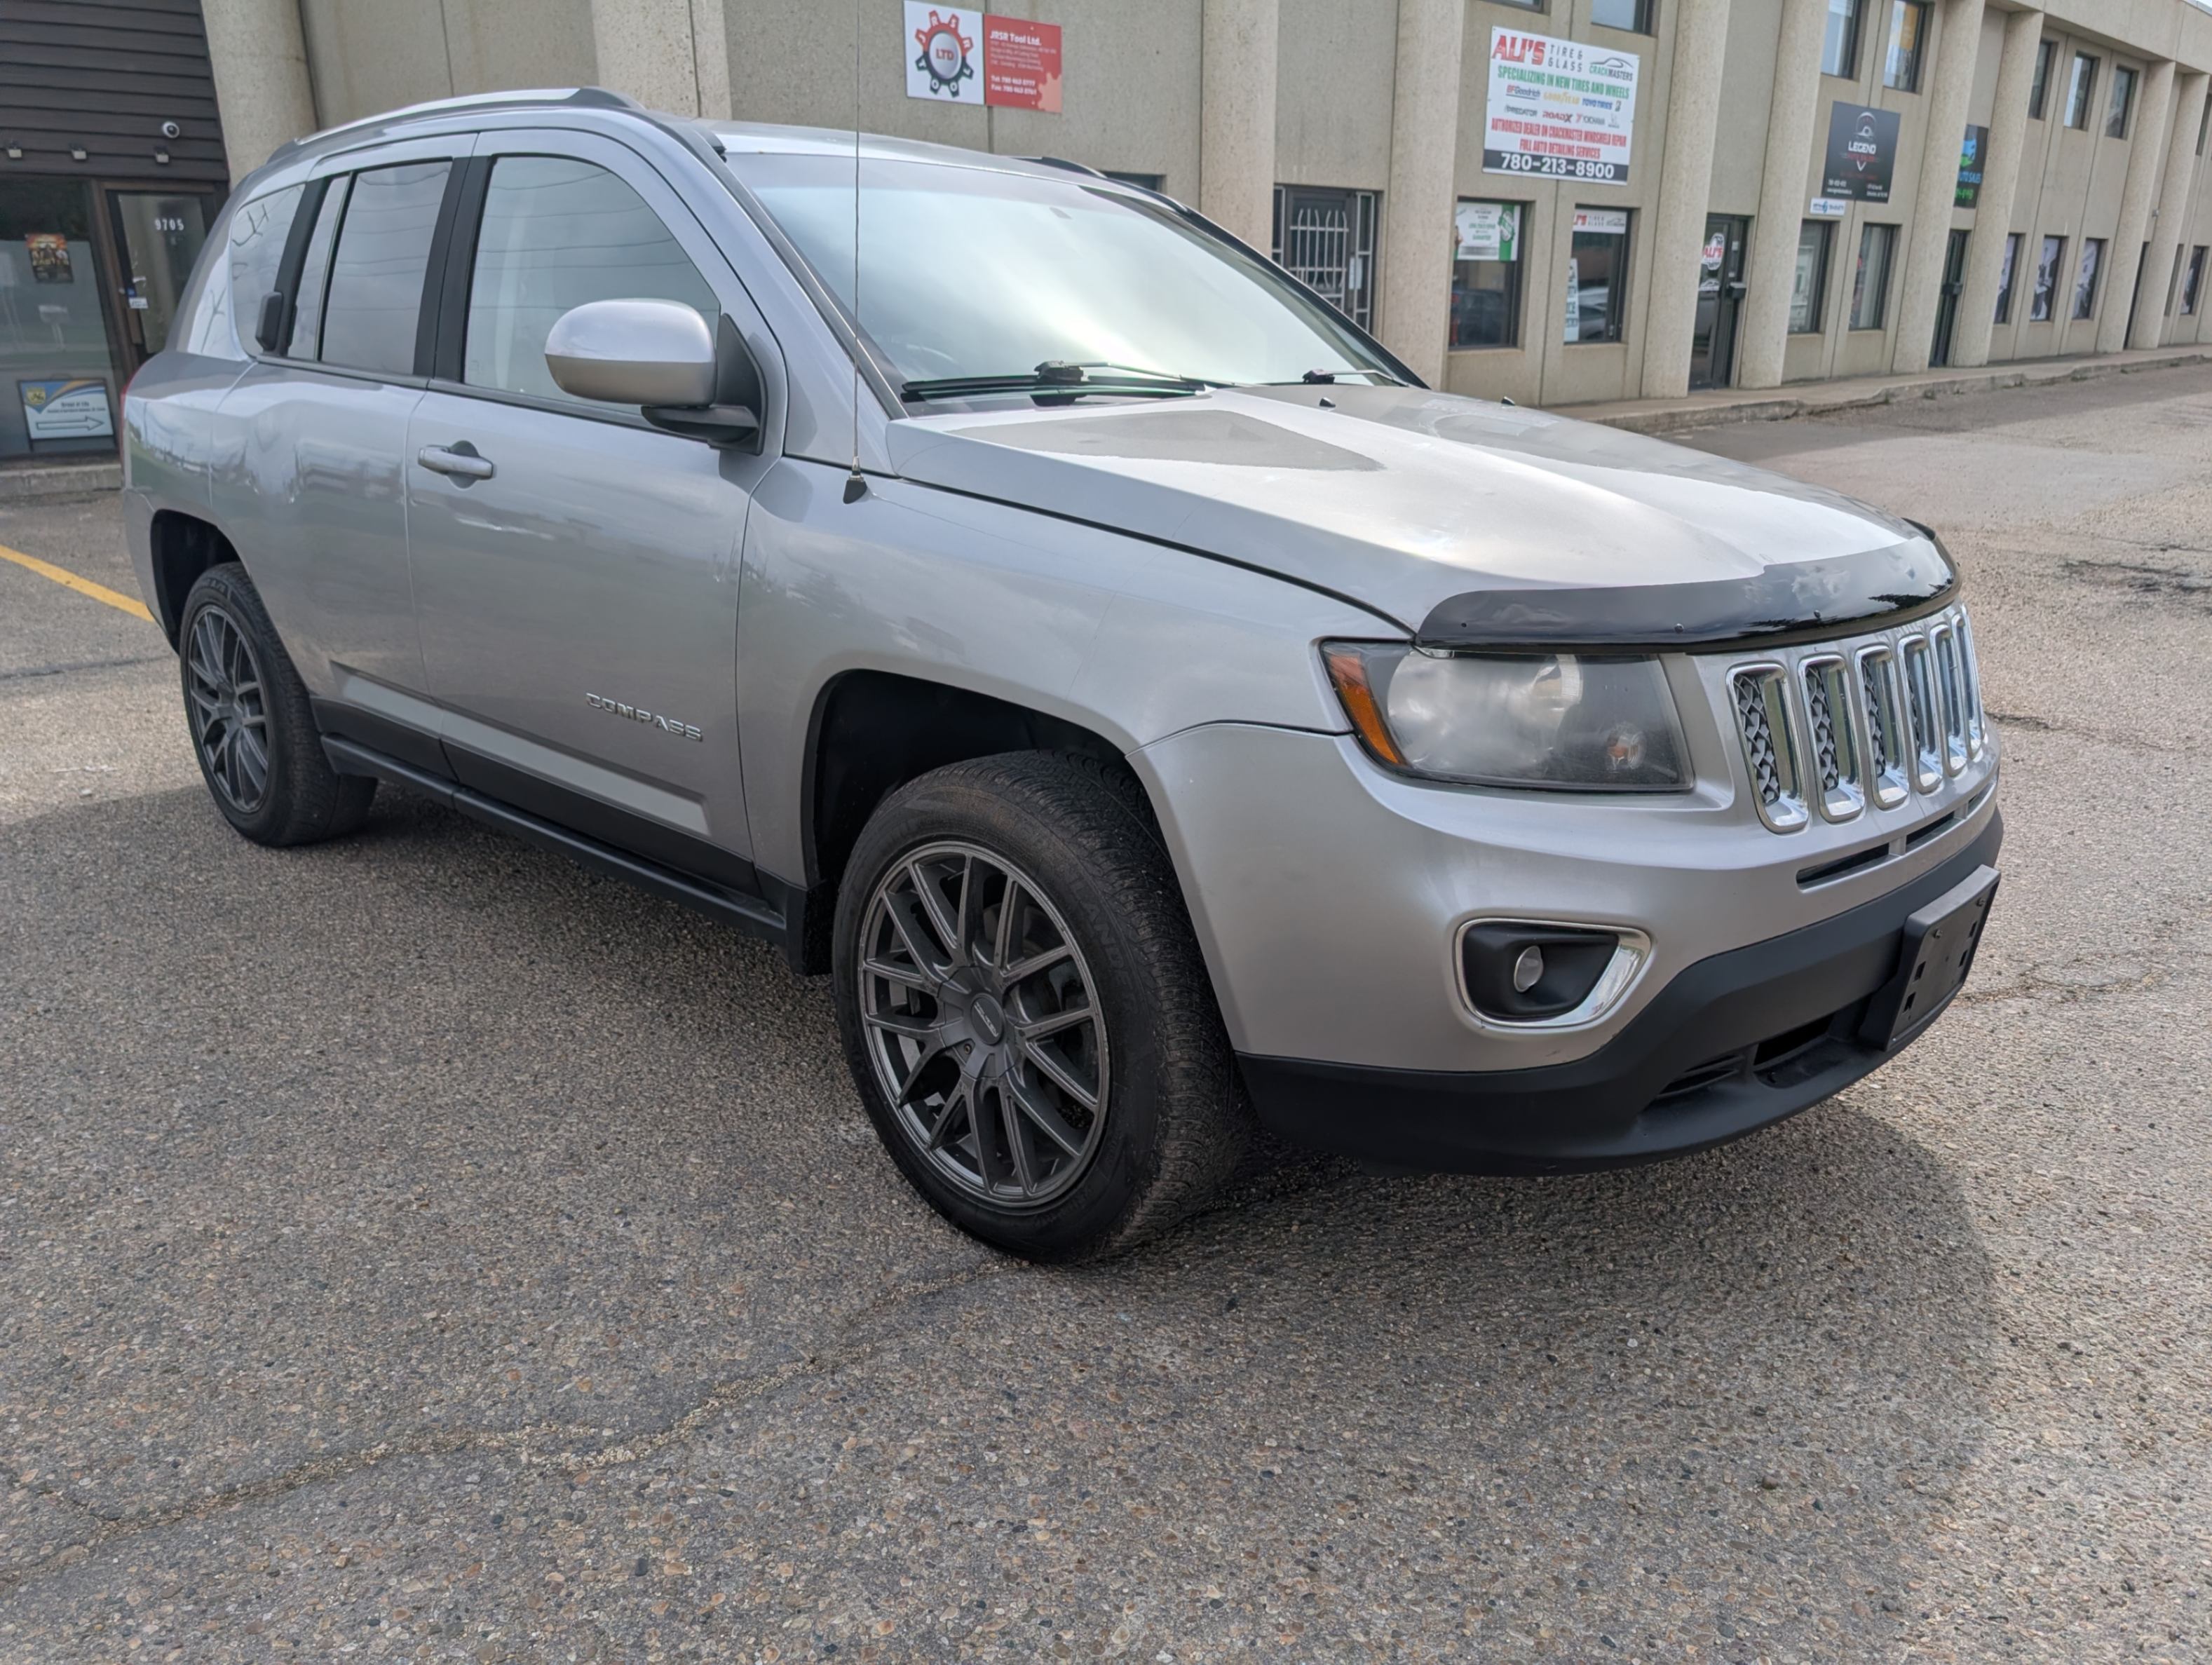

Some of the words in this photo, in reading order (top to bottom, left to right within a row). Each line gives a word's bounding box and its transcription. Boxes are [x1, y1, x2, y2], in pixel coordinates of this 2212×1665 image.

[990, 30, 1009, 41] JRSR
[1010, 33, 1026, 44] Tool
[1027, 35, 1042, 46] Ltd.
[936, 48, 955, 61] LTD
[1491, 34, 1547, 66] ALI'S
[1549, 44, 1575, 59] TIRE
[1577, 50, 1583, 60] &
[1547, 57, 1583, 73] GLASS
[1589, 64, 1634, 82] CRACKMASTERS
[1497, 64, 1545, 86] SPECIALIZING
[1547, 74, 1554, 87] IN
[1555, 75, 1570, 90] NEW
[1572, 78, 1590, 93] TIRES
[1591, 81, 1604, 95] AND
[1606, 84, 1630, 100] WHEELS
[1519, 138, 1532, 152] FULL
[1533, 140, 1548, 154] AUTO
[1576, 146, 1601, 161] SERVICES
[1847, 141, 1877, 155] LEGEND
[1500, 152, 1615, 179] 780-213-8900
[155, 218, 184, 231] 9705
[585, 693, 703, 742] COMPASS
